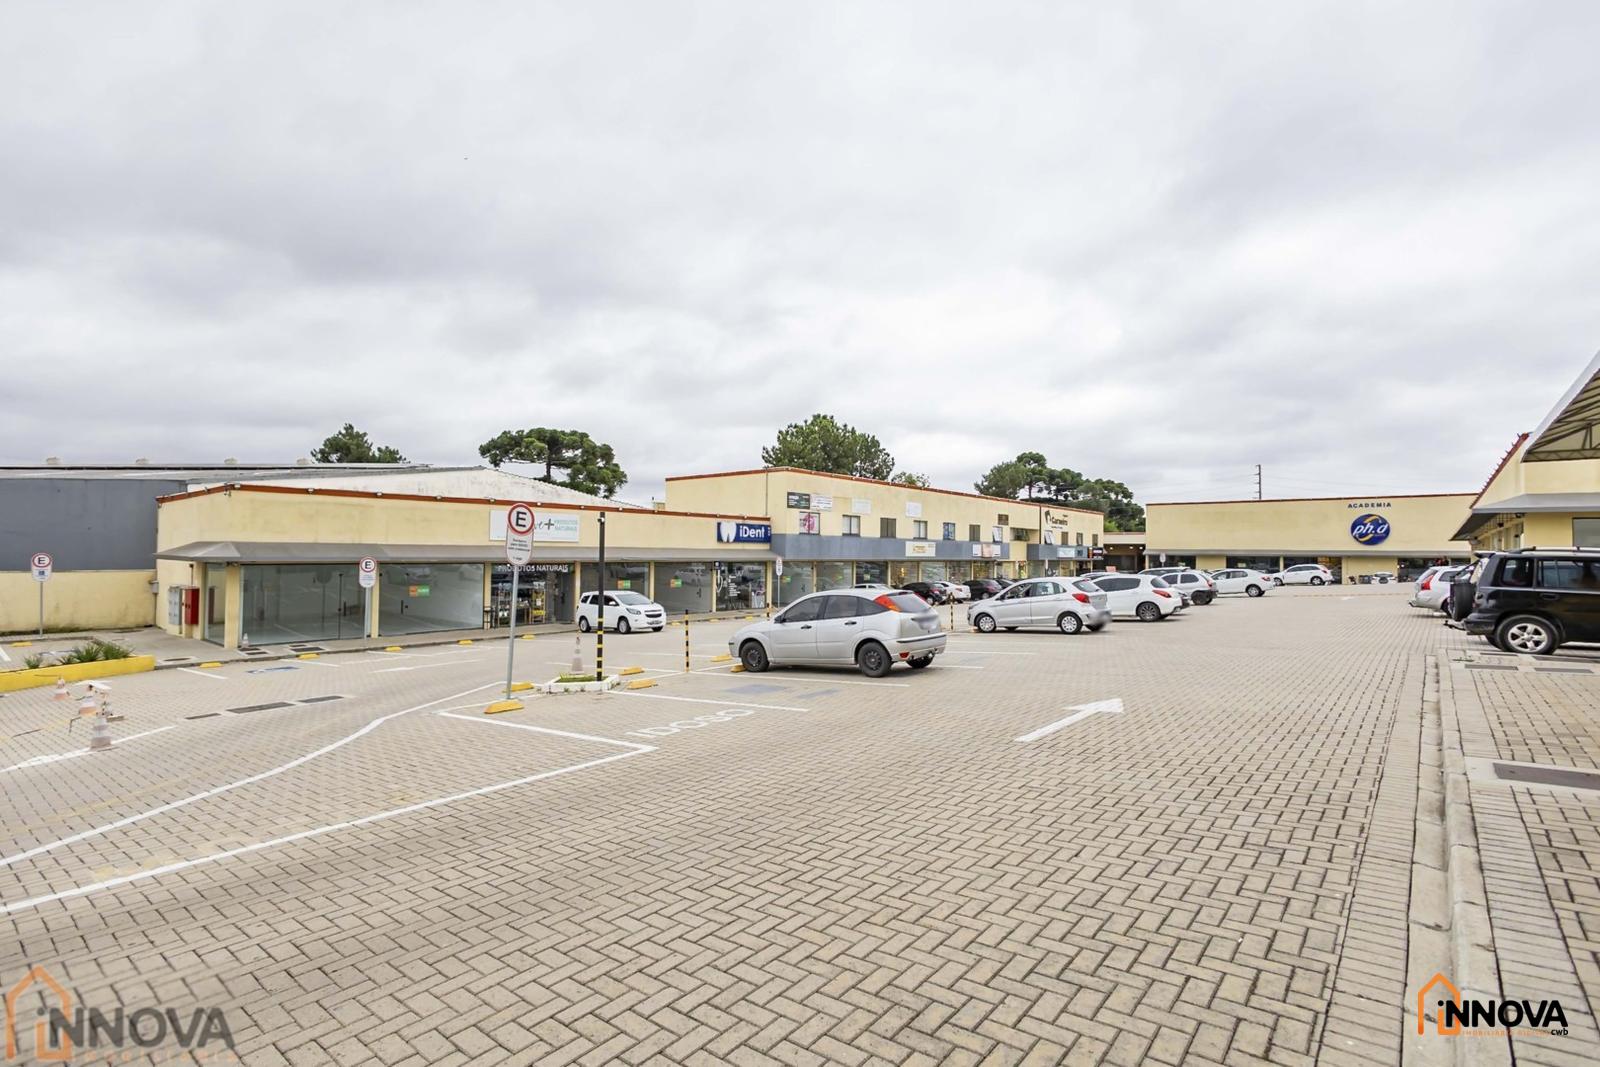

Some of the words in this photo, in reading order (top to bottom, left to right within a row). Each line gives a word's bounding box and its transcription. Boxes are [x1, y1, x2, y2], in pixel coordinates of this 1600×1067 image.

[515, 511, 527, 528] E
[739, 525, 765, 538] iDent
[37, 556, 46, 565] E
[364, 560, 372, 570] E
[496, 564, 536, 572] PROUTOS
[536, 564, 569, 573] NATURAIS
[624, 708, 756, 739] IDOSO
